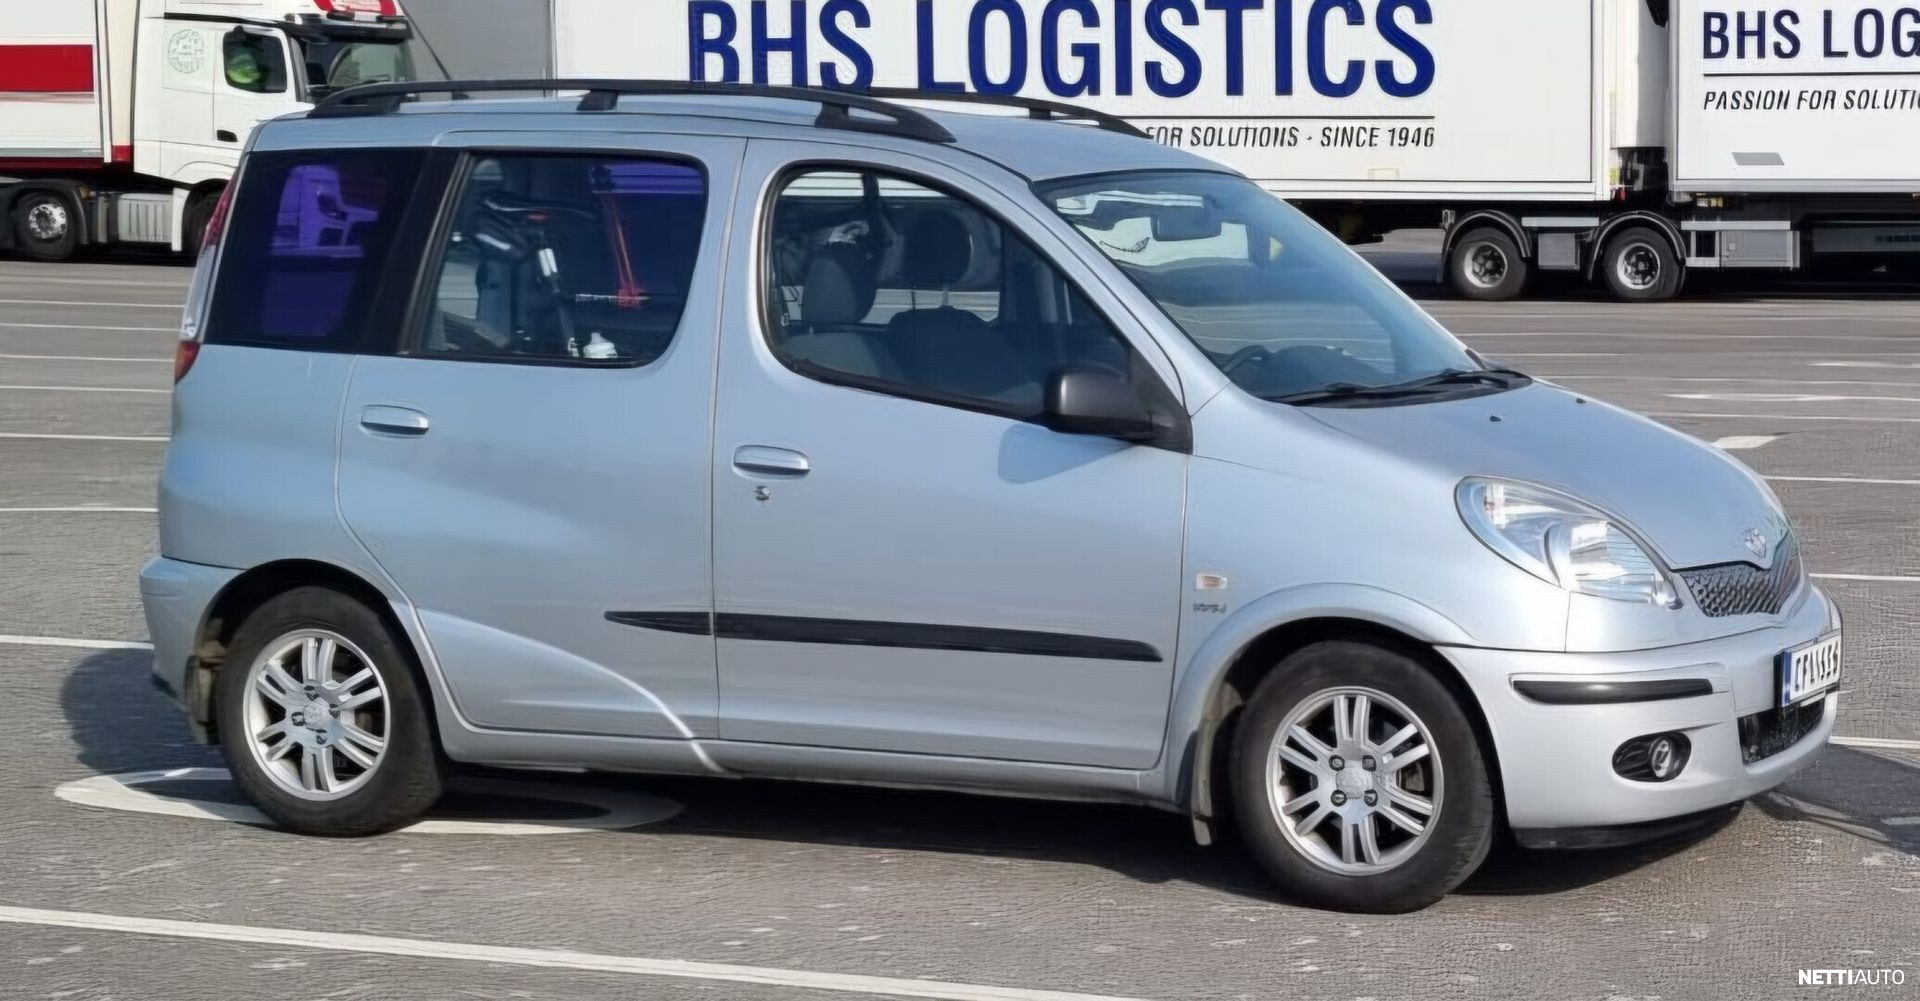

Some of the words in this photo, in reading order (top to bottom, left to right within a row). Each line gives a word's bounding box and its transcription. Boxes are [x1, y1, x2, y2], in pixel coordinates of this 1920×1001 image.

[689, 0, 873, 91] BHS
[916, 0, 1435, 97] LOGISTICS
[1703, 9, 1801, 59] BHS
[1703, 89, 1790, 110] PASSION
[1797, 89, 1837, 110] FOR
[1843, 88, 1920, 110] SOLUTI
[1190, 126, 1299, 147] SOLUTIONS
[1320, 126, 1380, 148] SINCE
[1388, 126, 1435, 147] 1946
